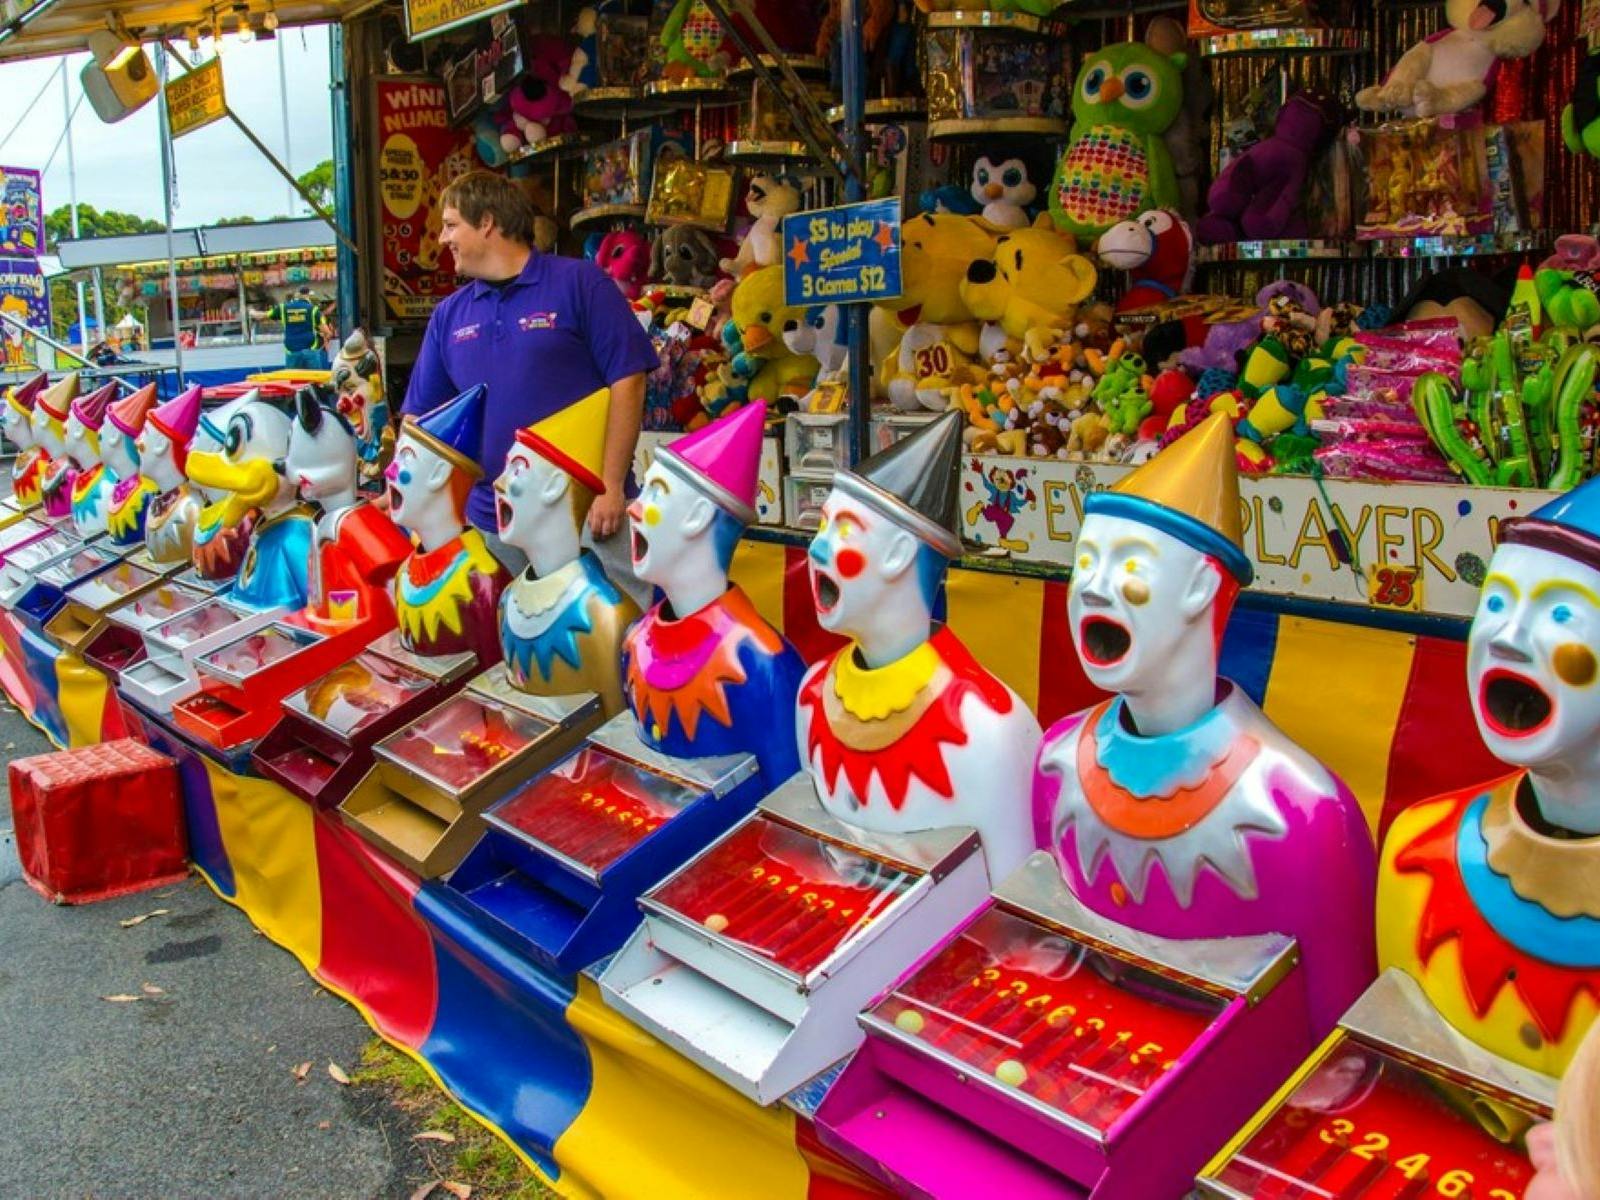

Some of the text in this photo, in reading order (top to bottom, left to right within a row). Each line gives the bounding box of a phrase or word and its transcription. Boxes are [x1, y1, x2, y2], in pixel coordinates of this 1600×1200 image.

[809, 216, 874, 245] $5 to play
[801, 265, 887, 297] 3 Games $12
[916, 345, 948, 377] 30
[1375, 567, 1417, 607] 25
[1319, 1117, 1356, 1145] 3
[1350, 1131, 1391, 1162] 2
[1394, 1152, 1432, 1180] 4
[1435, 1168, 1475, 1199] 6
